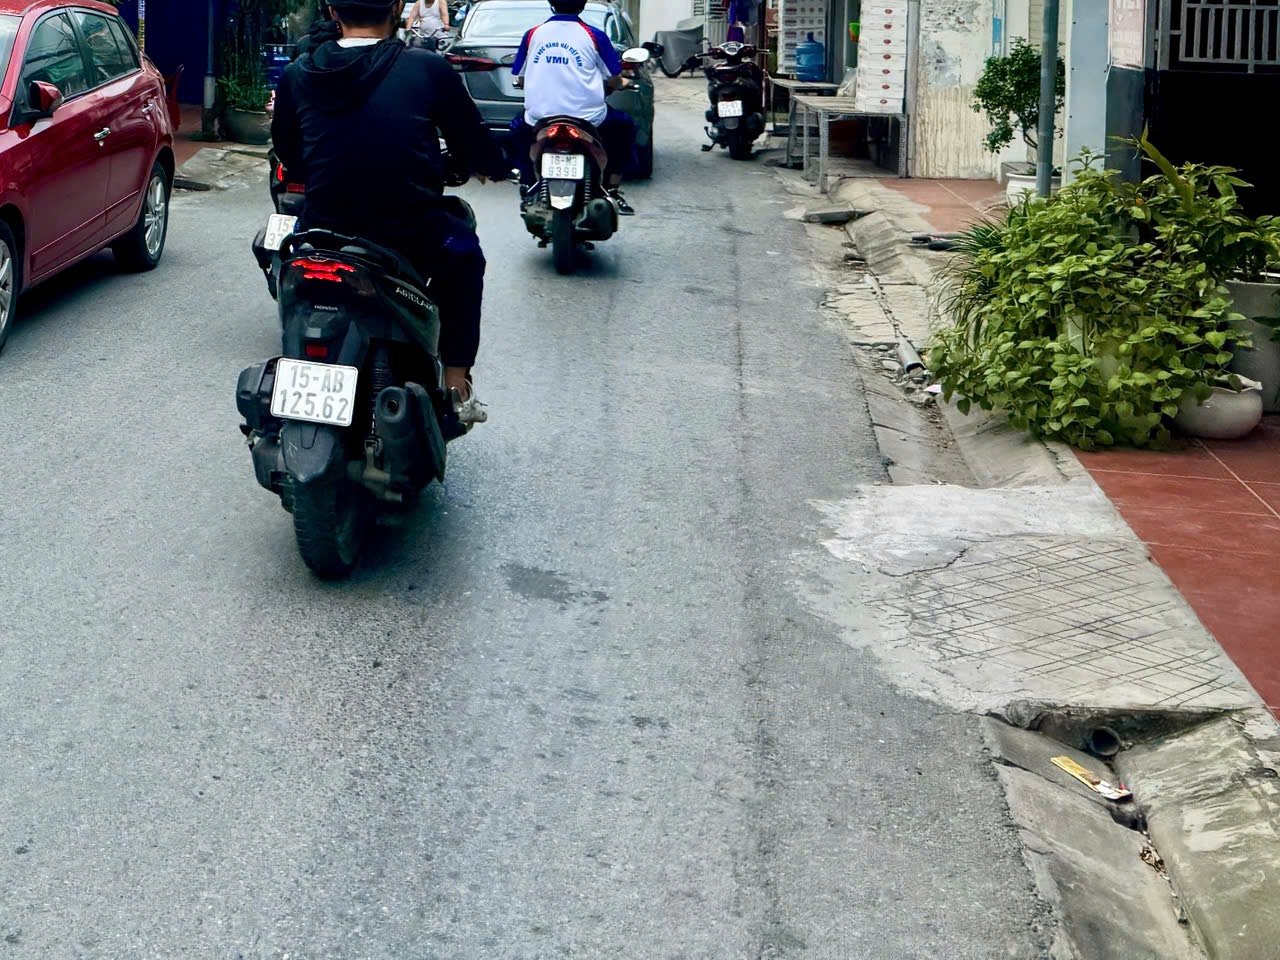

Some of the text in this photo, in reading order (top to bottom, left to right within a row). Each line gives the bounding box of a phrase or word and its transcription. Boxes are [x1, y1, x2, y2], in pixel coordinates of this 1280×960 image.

[546, 55, 569, 65] VMU
[290, 364, 344, 393] 15-AB
[280, 388, 349, 422] 125.62
